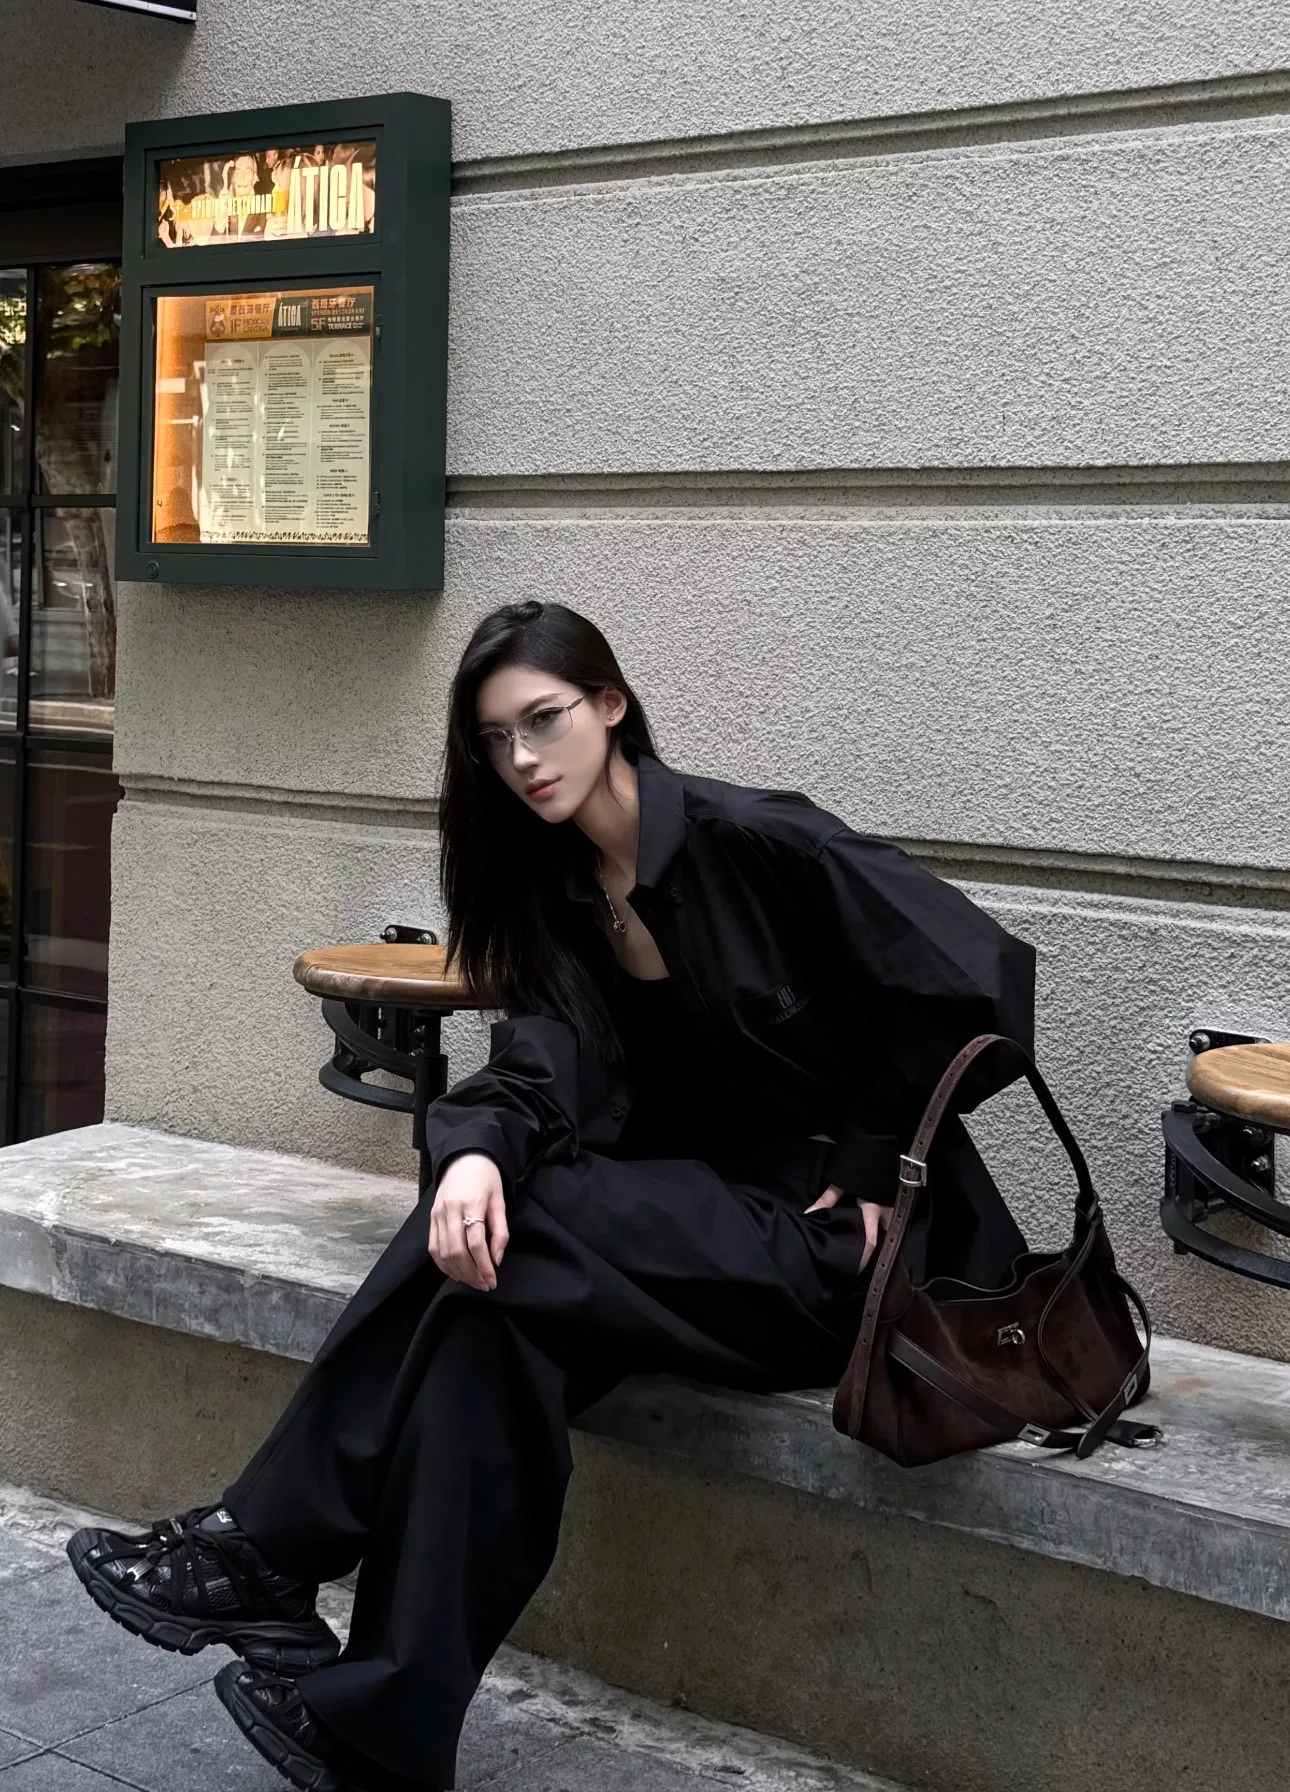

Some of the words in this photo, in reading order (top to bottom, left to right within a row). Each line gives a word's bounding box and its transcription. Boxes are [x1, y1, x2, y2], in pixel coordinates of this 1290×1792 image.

[286, 156, 365, 233] ÁTICA
[230, 303, 270, 315] 墨西哥餐厅
[312, 297, 357, 310] 西班牙餐厅
[278, 302, 301, 327] ÁTICA
[243, 325, 269, 333] CANTINA
[311, 317, 326, 331] 5F
[328, 322, 352, 330] TERRACE
